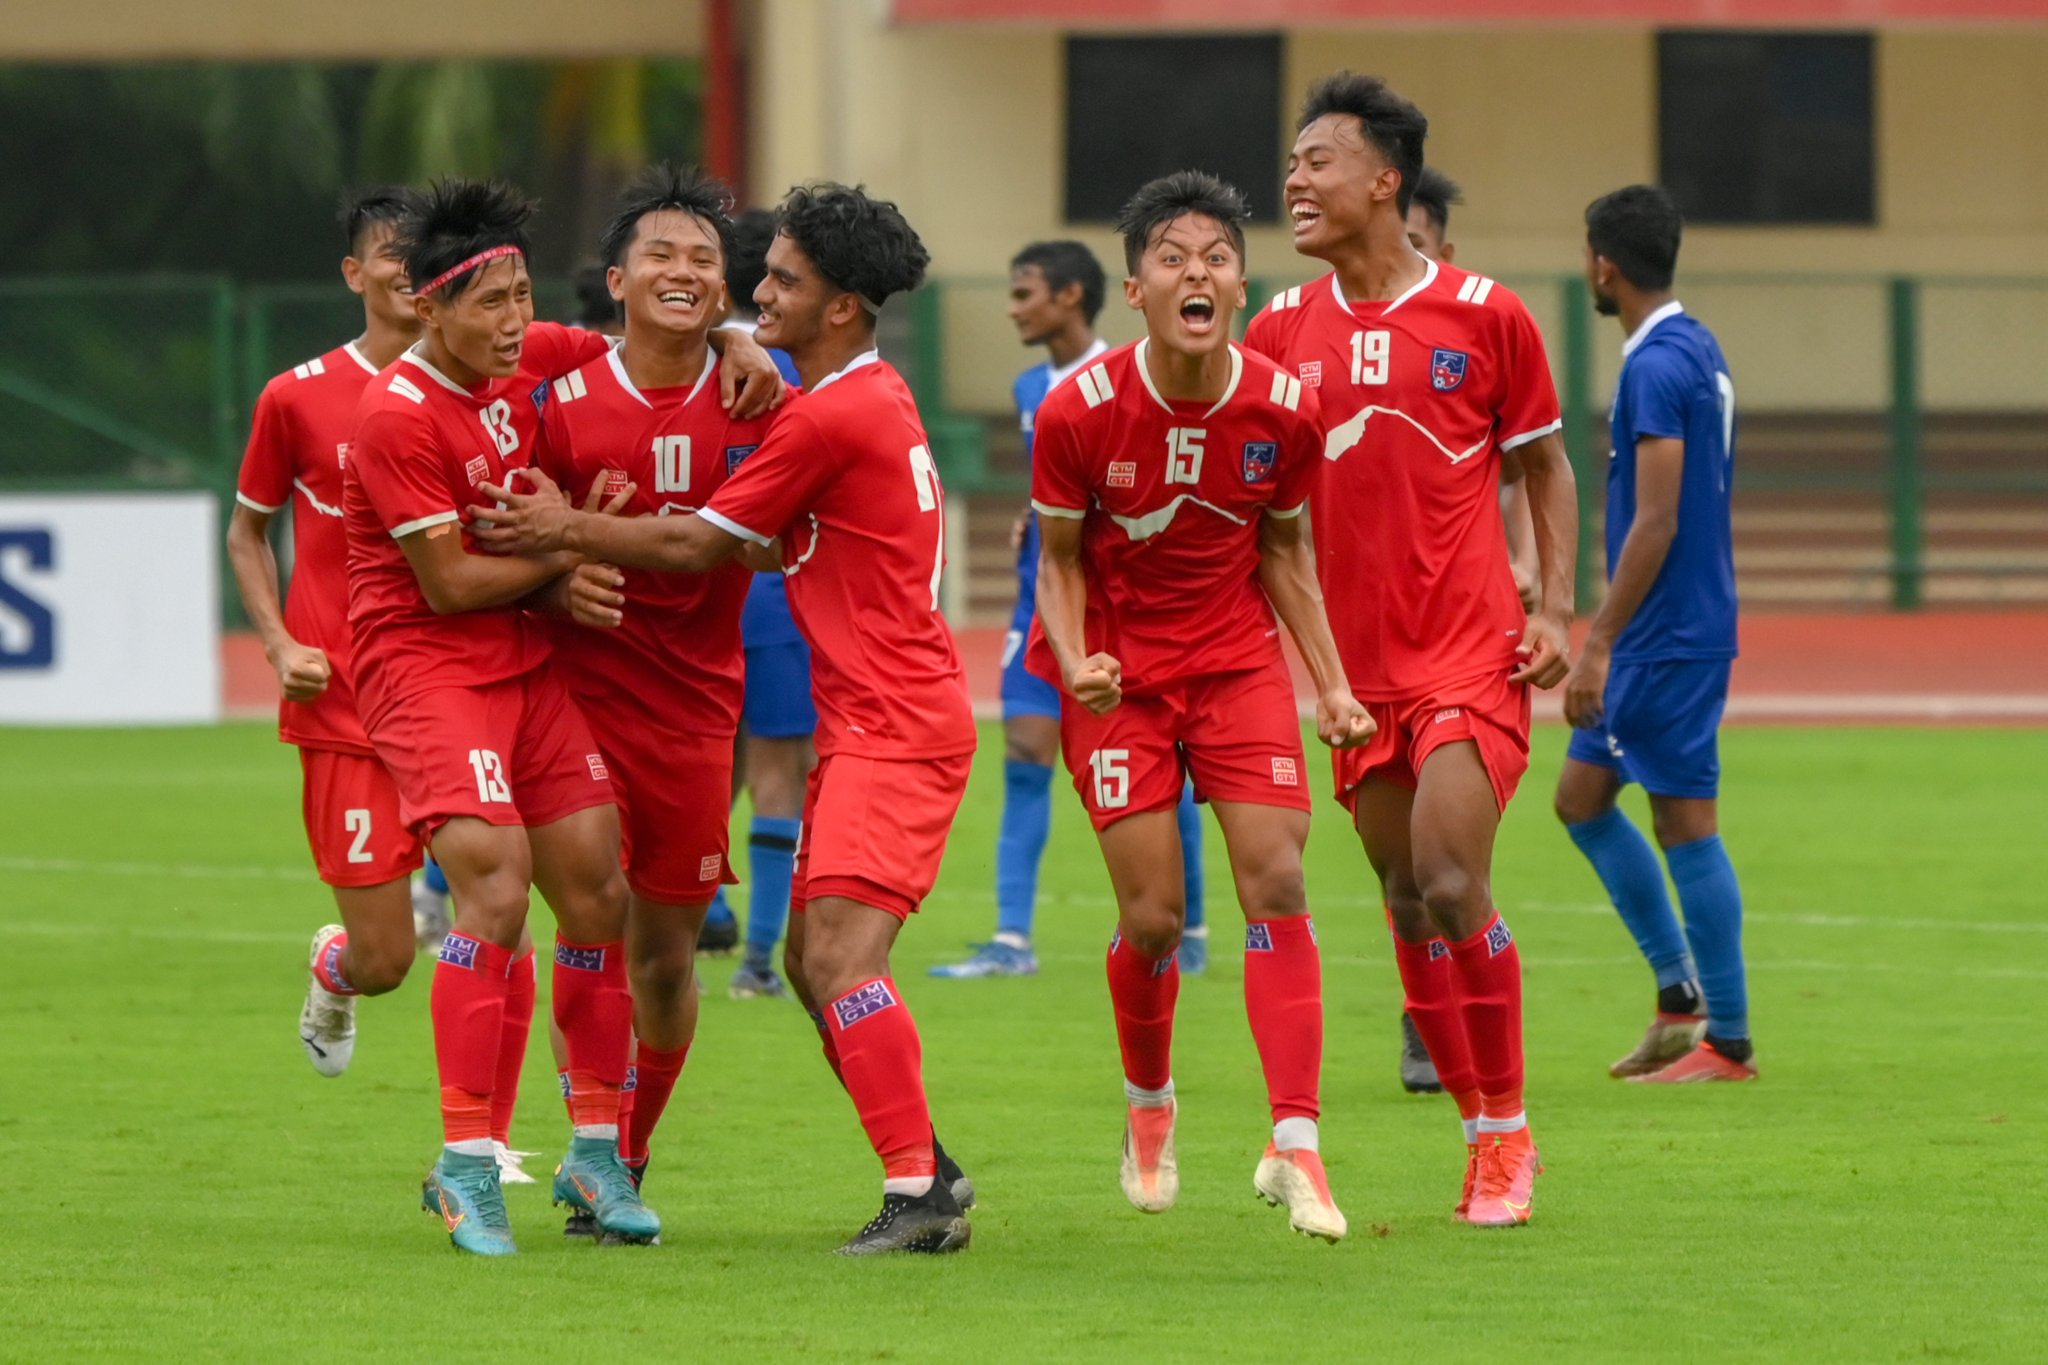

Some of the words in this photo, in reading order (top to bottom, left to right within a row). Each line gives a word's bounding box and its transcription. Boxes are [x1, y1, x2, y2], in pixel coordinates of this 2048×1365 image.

[1301, 365, 1319, 373] KTM
[1350, 330, 1390, 385] 19
[478, 398, 520, 460] 13
[1165, 427, 1206, 485] 15
[467, 458, 486, 472] KTM
[651, 435, 690, 493] 10
[1111, 465, 1133, 473] KTM
[0, 530, 54, 669] S
[468, 749, 512, 803] 13
[1089, 748, 1129, 808] 15
[1274, 761, 1294, 769] KTM
[345, 809, 373, 863] 2
[557, 953, 594, 968] CTY
[839, 983, 881, 1010] KTM
[845, 996, 885, 1021] CTY
